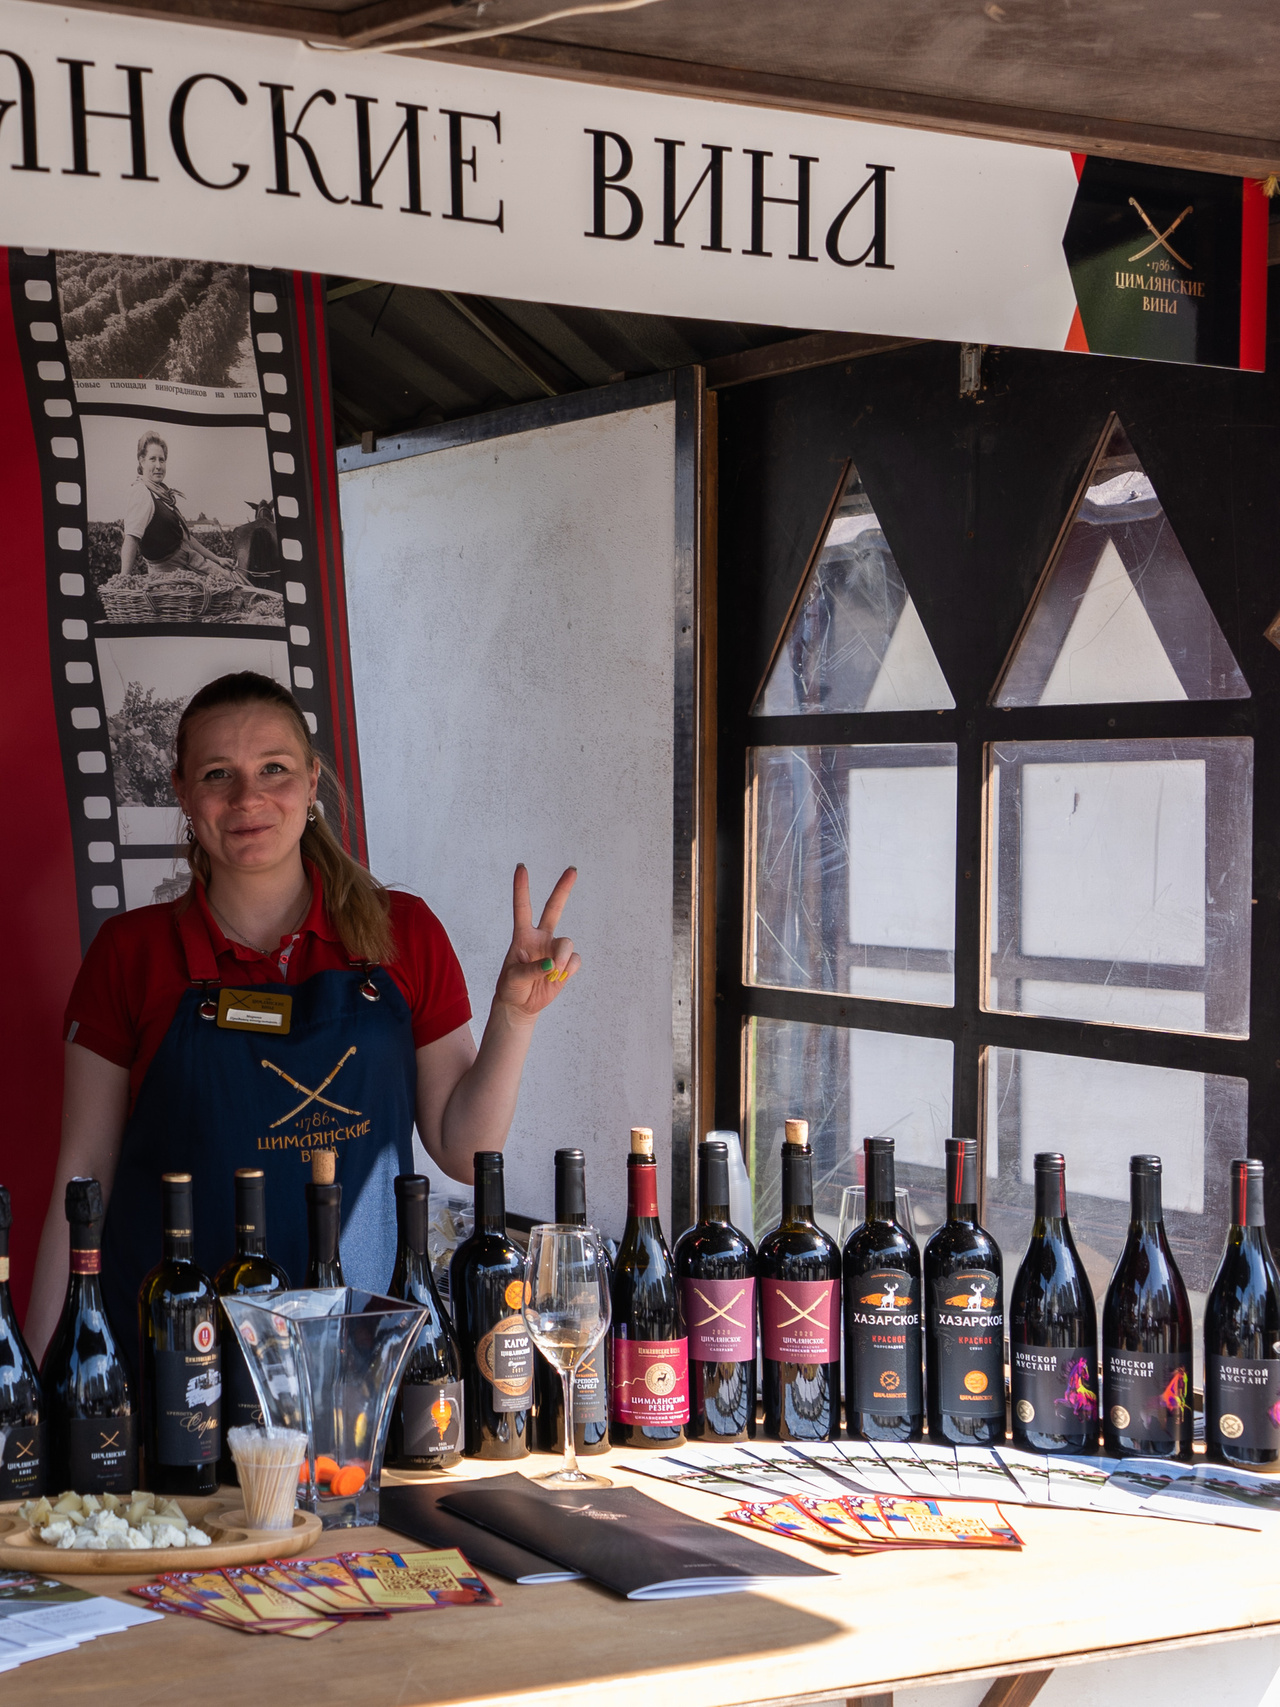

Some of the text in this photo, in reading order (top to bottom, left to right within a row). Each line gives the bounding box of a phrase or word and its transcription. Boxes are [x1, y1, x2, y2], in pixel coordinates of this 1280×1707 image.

[583, 128, 896, 271] ВИНА
[1151, 260, 1170, 273] 1786
[1115, 271, 1206, 298] ЦИМЛЯНСКИЕ
[1142, 296, 1178, 315] ВИНА
[109, 381, 147, 391] площади
[155, 383, 208, 398] виноградников
[214, 391, 225, 399] на
[233, 391, 258, 399] плато
[299, 1110, 330, 1132] 1786
[257, 1118, 372, 1151] ЦИМЛЯНСКИЕ
[301, 1145, 340, 1163] ВА
[853, 1312, 919, 1327] ХАЗАРСКОЕ
[938, 1313, 1004, 1328] ХАЗАРСКОЕ
[504, 1337, 529, 1349] КАГОР
[871, 1335, 907, 1344] КРАСНОЕ
[957, 1336, 993, 1345] КРАСНОЕ
[1015, 1352, 1057, 1364] ДОНСКОЙ
[1110, 1357, 1154, 1370] ДОНСКОЙ
[1016, 1360, 1057, 1372] МУСТАНГ
[1110, 1365, 1154, 1378] МУСТАНГ
[1219, 1365, 1269, 1377] ДОНСКОЙ
[1220, 1373, 1269, 1385] МУСТАНГ
[631, 1395, 686, 1405] ЦИМЛЯНСКИЙ
[648, 1404, 675, 1412] РЕЗЕРВ
